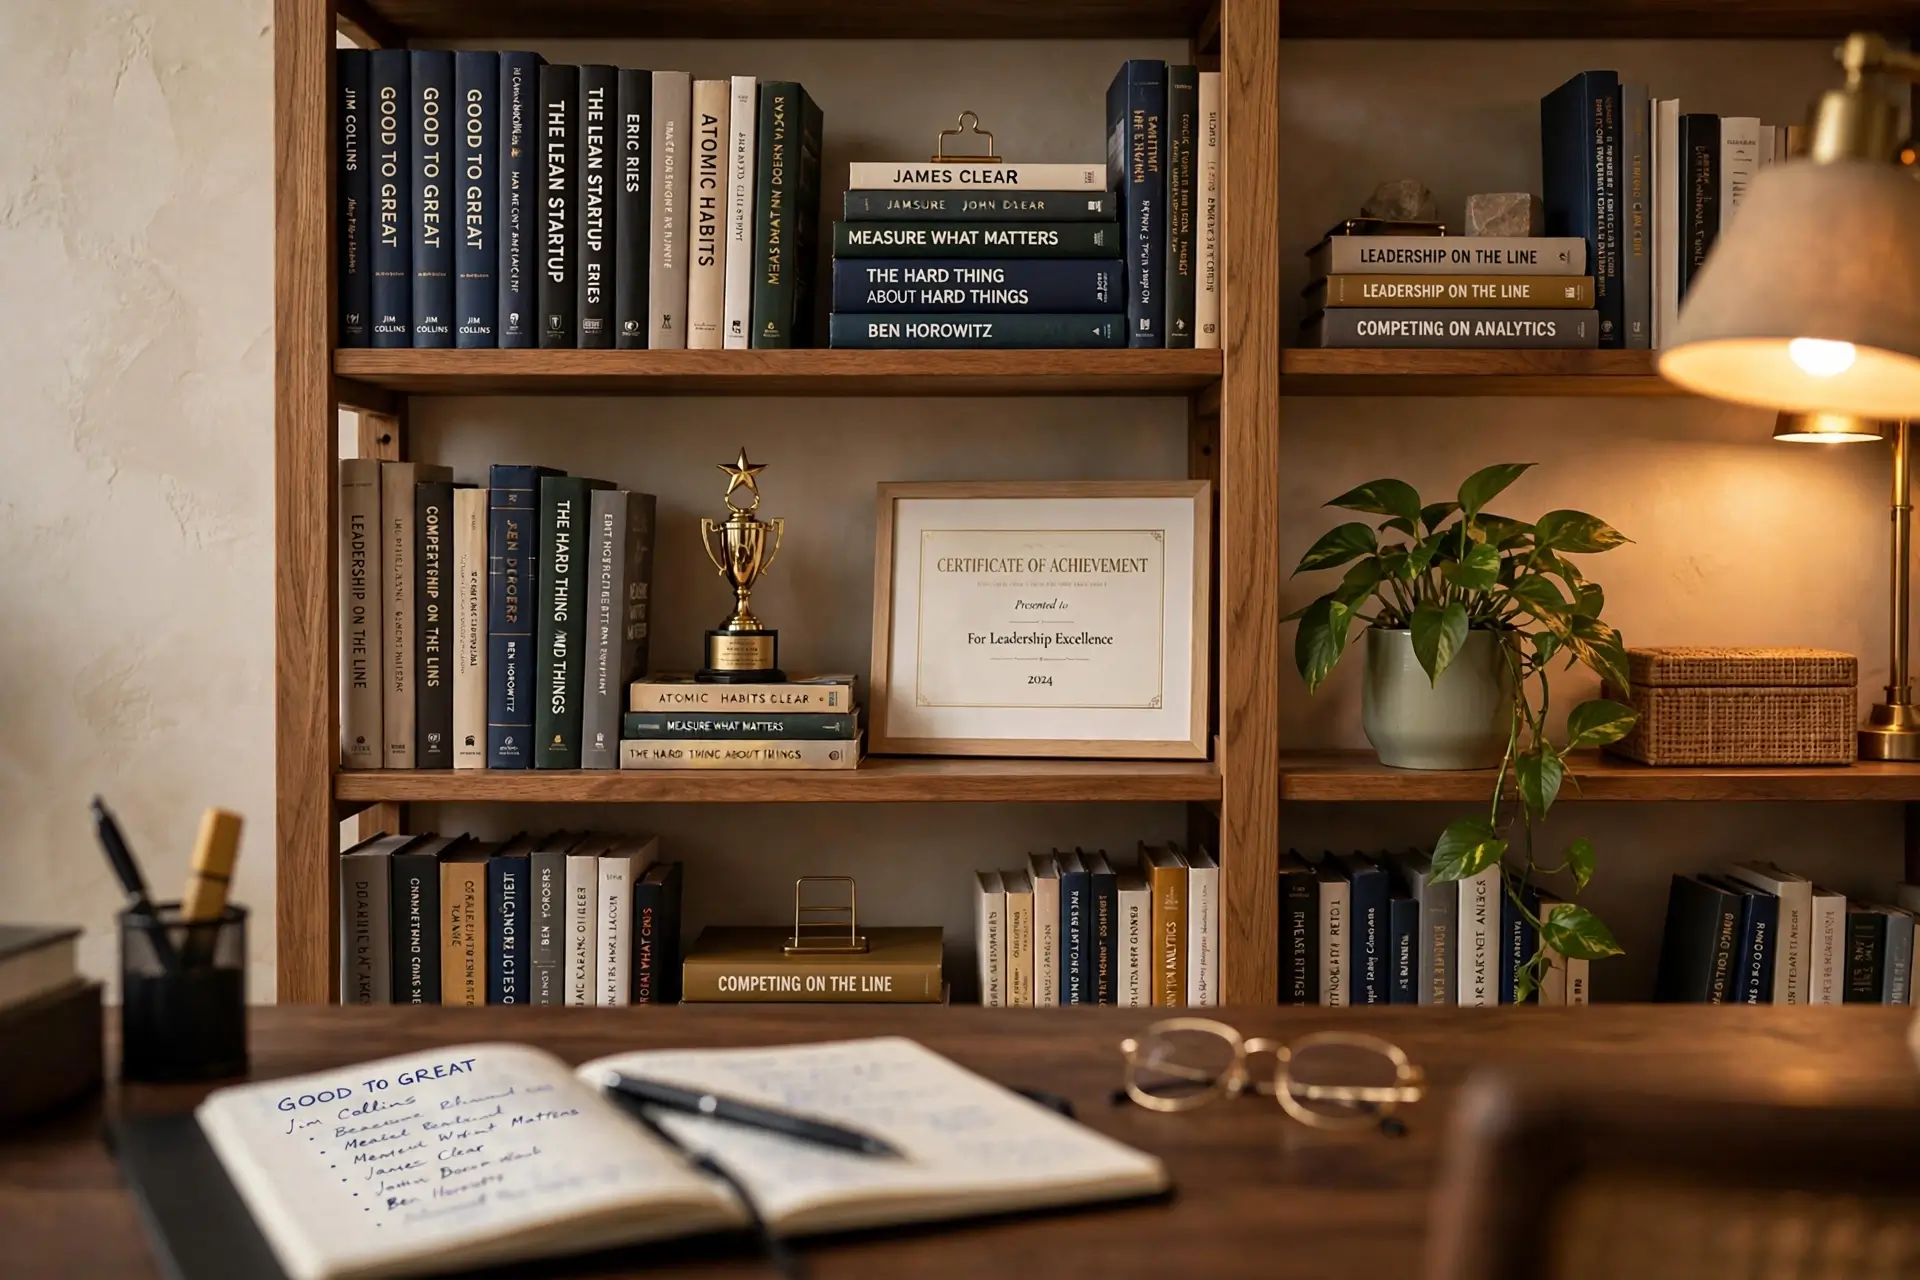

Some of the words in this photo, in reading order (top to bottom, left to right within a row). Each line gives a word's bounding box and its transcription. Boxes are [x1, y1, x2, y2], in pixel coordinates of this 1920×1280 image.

[345, 87, 356, 110] JIM
[588, 87, 604, 120] THE
[380, 86, 397, 145] GOOD
[423, 87, 440, 146] GOOD
[466, 88, 483, 148] GOOD
[548, 100, 565, 137] THE
[346, 114, 358, 171] COLLINS
[626, 113, 640, 150] ERIC
[588, 125, 603, 168] LEAN
[699, 113, 718, 189] ATOMIC
[381, 150, 397, 177] TO
[423, 152, 440, 178] TO
[466, 154, 483, 180] TO
[548, 143, 565, 189] LEAN
[626, 156, 639, 193] RIES
[893, 168, 952, 184] JAMES
[959, 169, 1018, 185] CLEAR
[381, 183, 397, 248] GREAT
[423, 184, 440, 249] GREAT
[466, 186, 483, 250] GREAT
[587, 174, 603, 251] STARTUP
[962, 200, 996, 212] JOHN
[547, 197, 564, 283] STARTUP
[698, 196, 716, 267] HABITS
[848, 230, 926, 246] MEASURE
[931, 230, 979, 246] WHAT
[984, 230, 1059, 246] MATTERS
[1360, 248, 1447, 264] LEADERSHIP
[1451, 249, 1471, 263] ON
[1475, 249, 1502, 264] THE
[1507, 250, 1538, 265] LINE
[587, 263, 601, 304] ERIES
[867, 268, 899, 283] THE
[904, 268, 950, 283] HARD
[953, 268, 1005, 283] THING
[866, 289, 917, 304] ABOUT
[921, 289, 966, 304] HARD
[970, 289, 1029, 304] THINGS
[1363, 283, 1444, 298] LEADERSHIP
[1448, 284, 1468, 298] ON
[1472, 284, 1497, 298] THE
[1501, 284, 1530, 298] LINE
[374, 325, 406, 333] COLLINS
[383, 315, 396, 323] JIM
[459, 326, 491, 334] COLLINS
[868, 323, 901, 338] BEN
[905, 323, 993, 338] HOROWITZ
[1357, 321, 1444, 337] COMPETING
[1449, 321, 1471, 336] ON
[1474, 321, 1556, 337] ANALYTICS
[556, 500, 570, 528] THE
[351, 514, 365, 600] LEADERSHIP
[555, 532, 569, 573] HARD
[937, 557, 1024, 574] CERTIFICATE
[1028, 557, 1046, 573] OF
[1050, 557, 1149, 574] ACHIEVEMENT
[554, 577, 569, 622] THING
[1014, 598, 1058, 611] Presented
[353, 605, 366, 625] ON
[427, 604, 440, 622] ON
[353, 630, 367, 654] THE
[426, 627, 440, 652] THE
[507, 639, 516, 657] BEN
[967, 632, 986, 645] For
[990, 631, 1052, 649] Leadership
[1055, 631, 1114, 646] Excellence
[354, 658, 368, 689] LINE
[427, 657, 440, 687] LINS
[1027, 675, 1053, 687] 2024
[552, 666, 567, 715] THINGS
[659, 693, 709, 704] ATOMIC
[720, 693, 766, 704] HABITS
[770, 694, 810, 704] CLEAR
[667, 720, 711, 732] MEASURE
[713, 721, 740, 731] WHAT
[742, 721, 784, 732] MATTERS
[541, 926, 550, 945] BEN
[718, 975, 801, 992] COMPETING
[806, 976, 825, 992] ON
[830, 976, 857, 992] THE
[861, 976, 892, 992] LINE
[277, 1087, 352, 1112] GOOD
[362, 1079, 389, 1093] TO
[398, 1058, 476, 1086] GREAT
[286, 1118, 322, 1135] Jim
[337, 1095, 417, 1121] Collins
[438, 1143, 485, 1161] Clear
